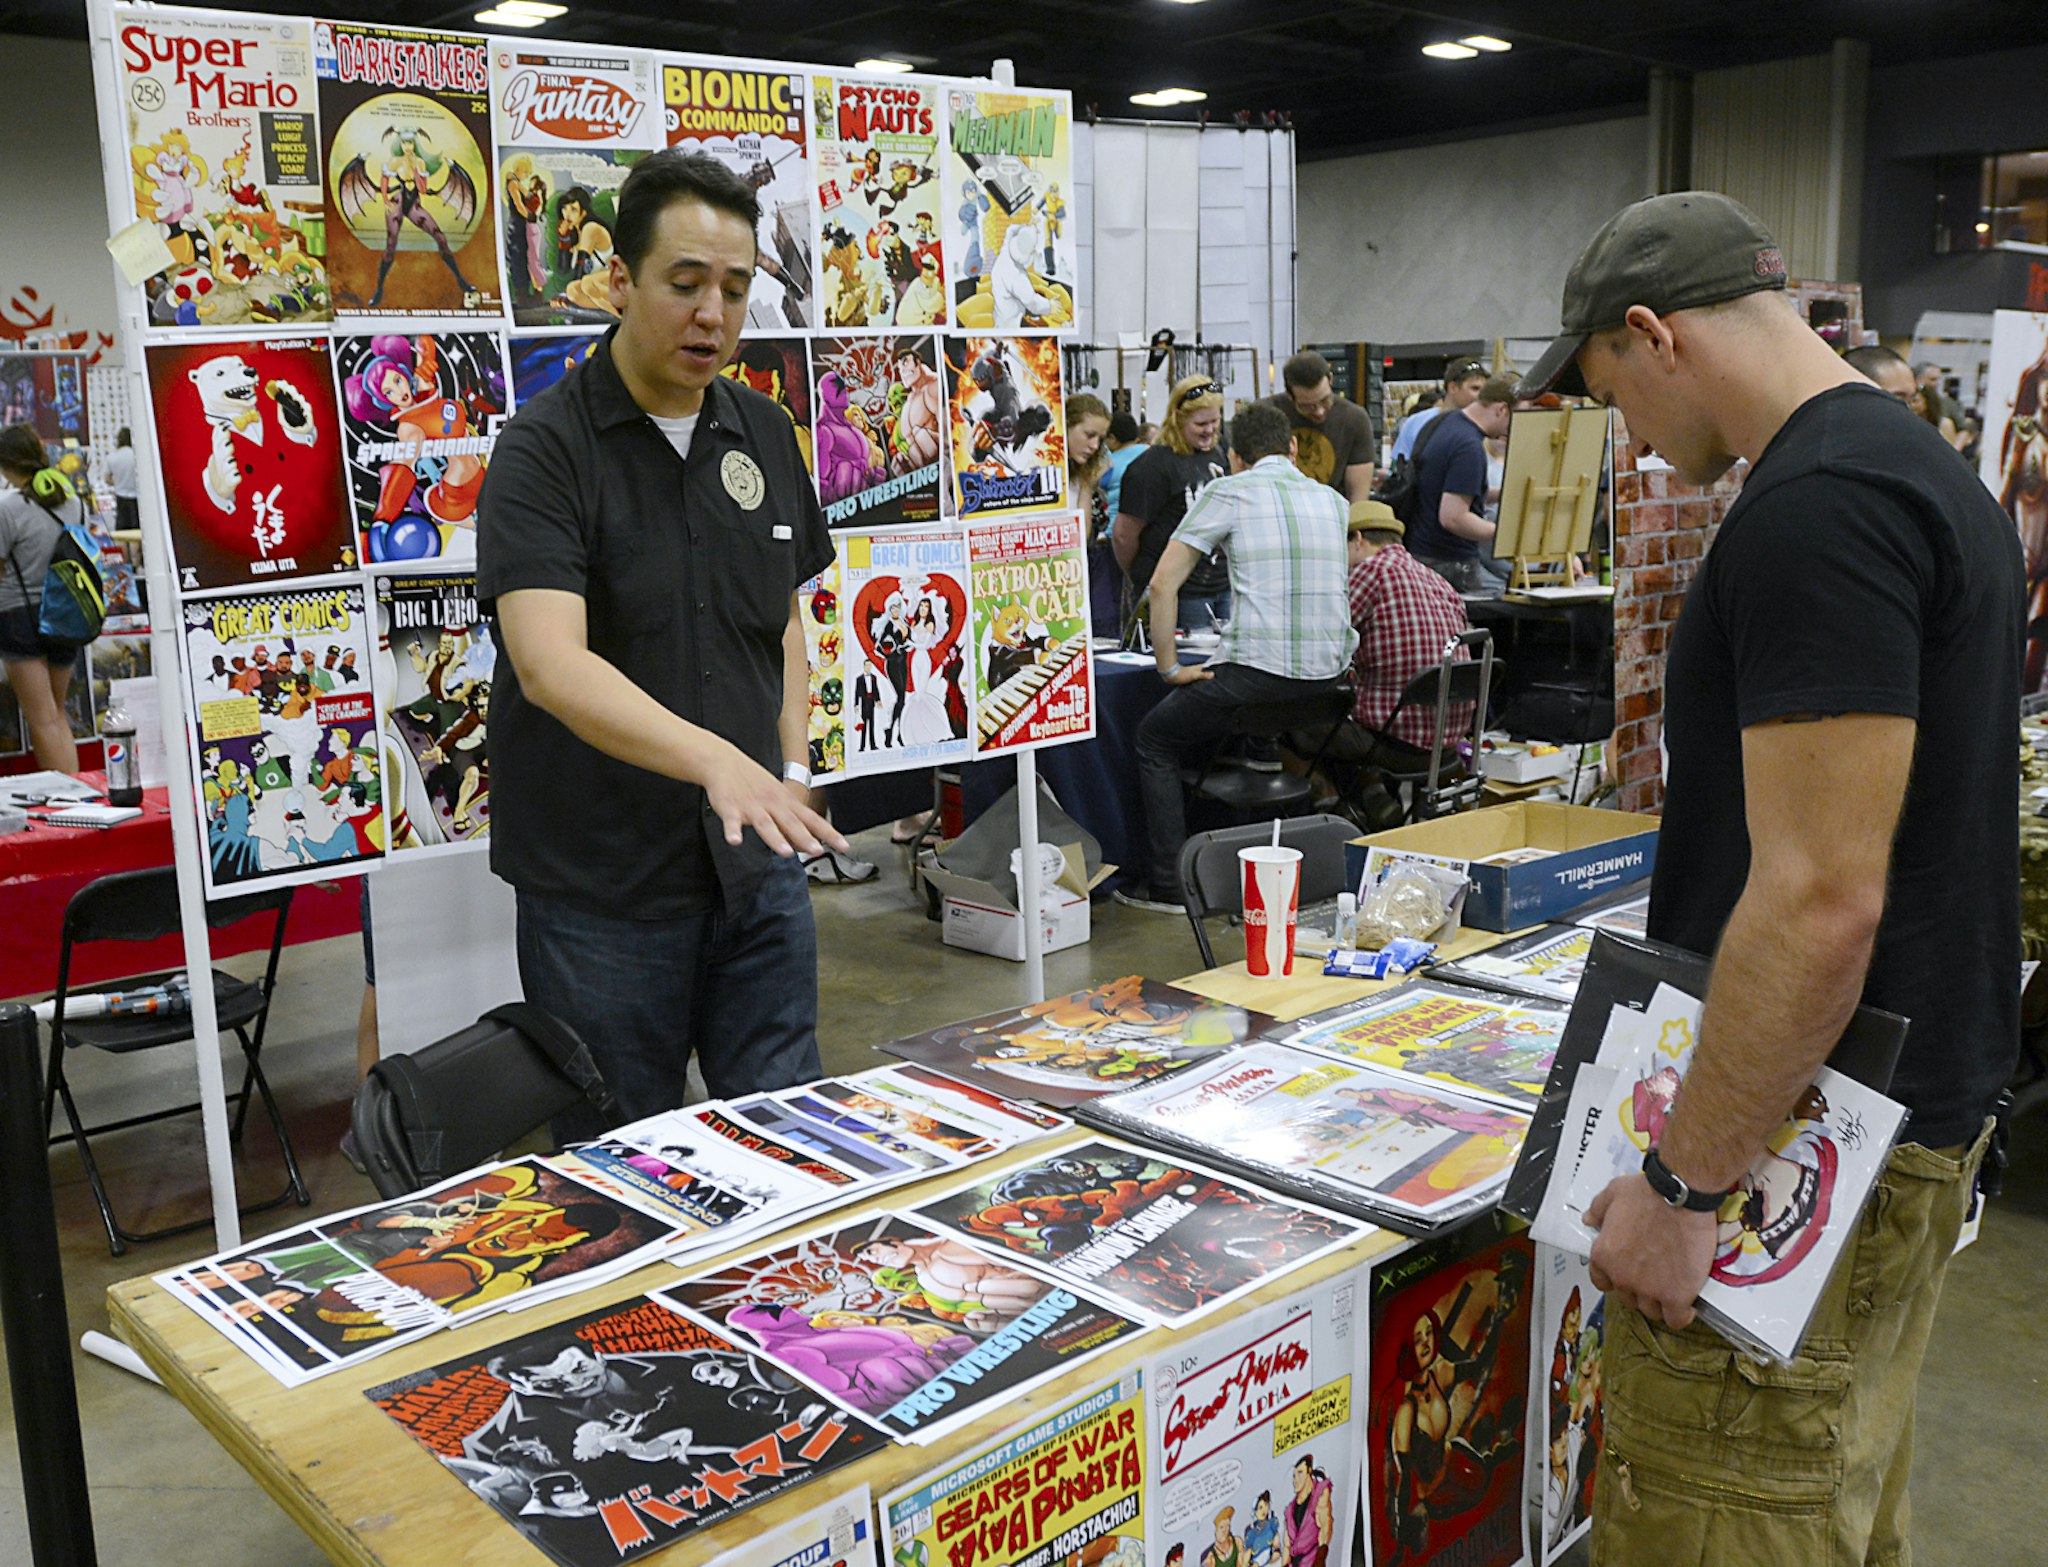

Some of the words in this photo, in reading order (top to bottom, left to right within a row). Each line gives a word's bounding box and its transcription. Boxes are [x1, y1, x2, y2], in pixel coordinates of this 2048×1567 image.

[121, 26, 258, 85] Super
[337, 34, 488, 92] DARKSTALKERS
[187, 72, 297, 109] Mario
[540, 74, 573, 88] FINAL
[664, 67, 791, 113] BIONIC
[840, 85, 921, 107] PSYCHO
[186, 111, 252, 128] Brothers
[503, 70, 645, 140] Fantasy
[681, 108, 786, 134] COMMANDO
[837, 102, 934, 143] NAUTS
[271, 143, 307, 153] PRINCESS
[356, 440, 417, 467] SPACE
[827, 498, 857, 524] PRO
[858, 466, 940, 512] WRESTLING
[872, 544, 910, 567] GREAT
[916, 542, 961, 565] COMICS
[1024, 526, 1058, 548] MARCH
[250, 560, 278, 574] KUMA
[278, 557, 298, 572] UTA
[972, 558, 1082, 598] KEYBOARD
[213, 603, 271, 643] GREAT
[280, 590, 350, 632] COMICS
[395, 600, 427, 628] BIG
[432, 598, 493, 626] LEBO
[1028, 580, 1082, 626] CAT
[1555, 852, 1642, 885] HAMMERMILL
[606, 1164, 669, 1201] STEREO
[664, 1194, 724, 1226] SOUND
[893, 1375, 956, 1428] PRO
[949, 1287, 1078, 1387] WRESTLING
[1234, 1382, 1290, 1430] ALPHA
[1293, 1398, 1337, 1428] LEGION
[931, 1446, 1012, 1500] MICROSOFT
[1015, 1420, 1055, 1454] GAME
[1057, 1387, 1114, 1428] STUDIOS
[946, 1465, 1010, 1506] MICROSOFT
[1012, 1440, 1056, 1470] TEAM-UP
[1058, 1408, 1110, 1446] FEATURING
[936, 1468, 1032, 1543] GEARS
[1034, 1447, 1068, 1486] OF
[1071, 1408, 1136, 1463] WAR
[947, 1500, 1028, 1567] VIVA
[1053, 1495, 1137, 1562] HORSTACHIO!
